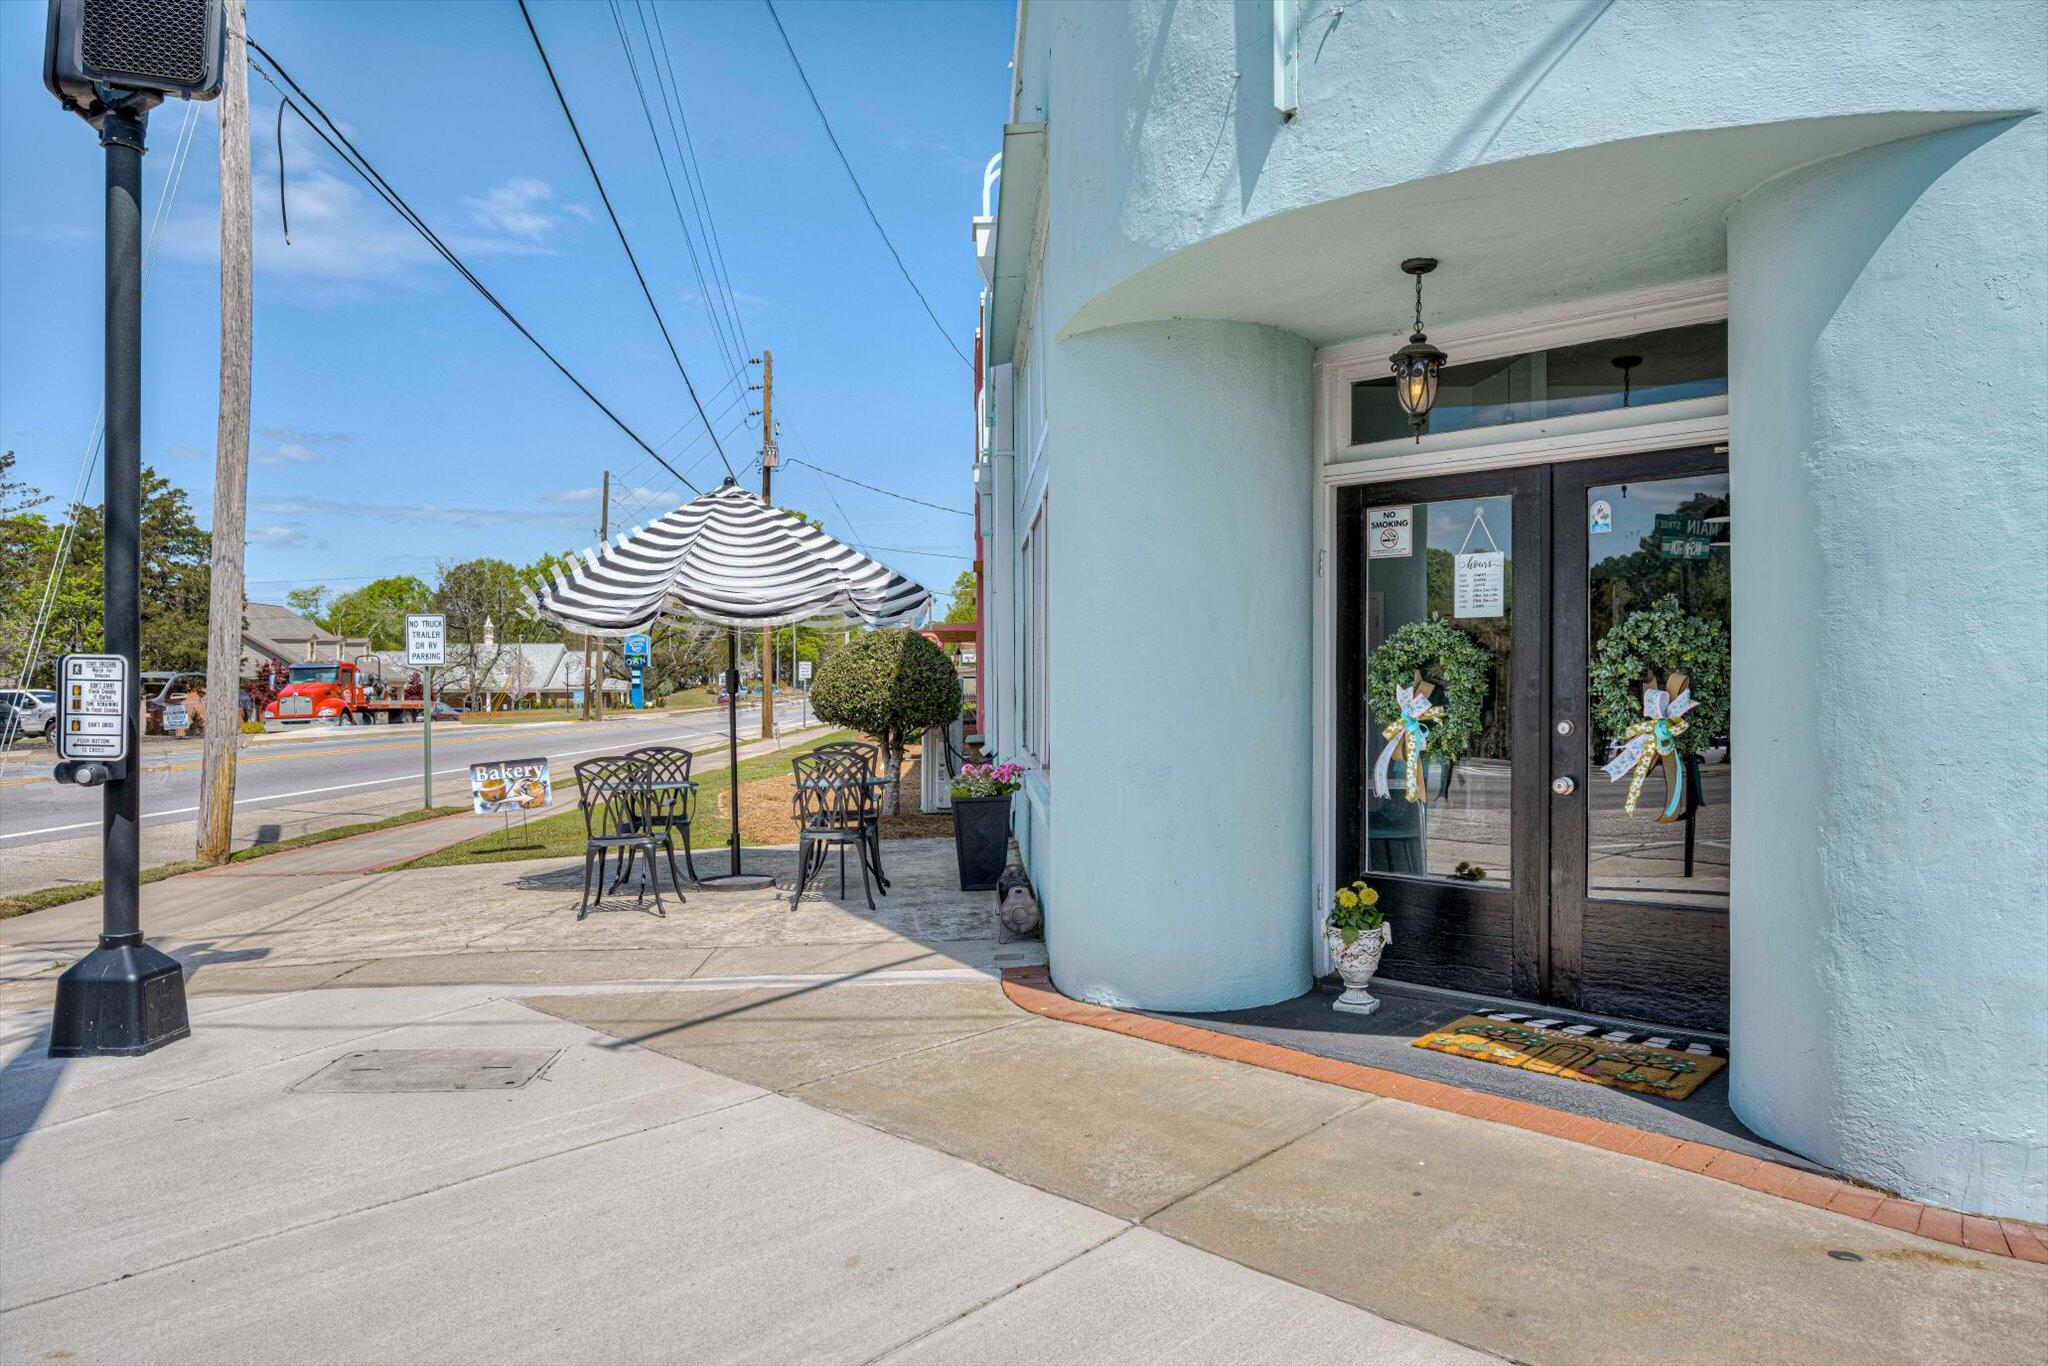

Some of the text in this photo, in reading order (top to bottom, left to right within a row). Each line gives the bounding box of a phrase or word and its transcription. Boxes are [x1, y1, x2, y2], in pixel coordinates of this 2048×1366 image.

[1371, 519, 1408, 529] SMOKING
[1467, 556, 1492, 570] hours
[412, 631, 441, 639] TRAILER
[412, 652, 441, 661] PARKING
[475, 762, 544, 781] Bakery
